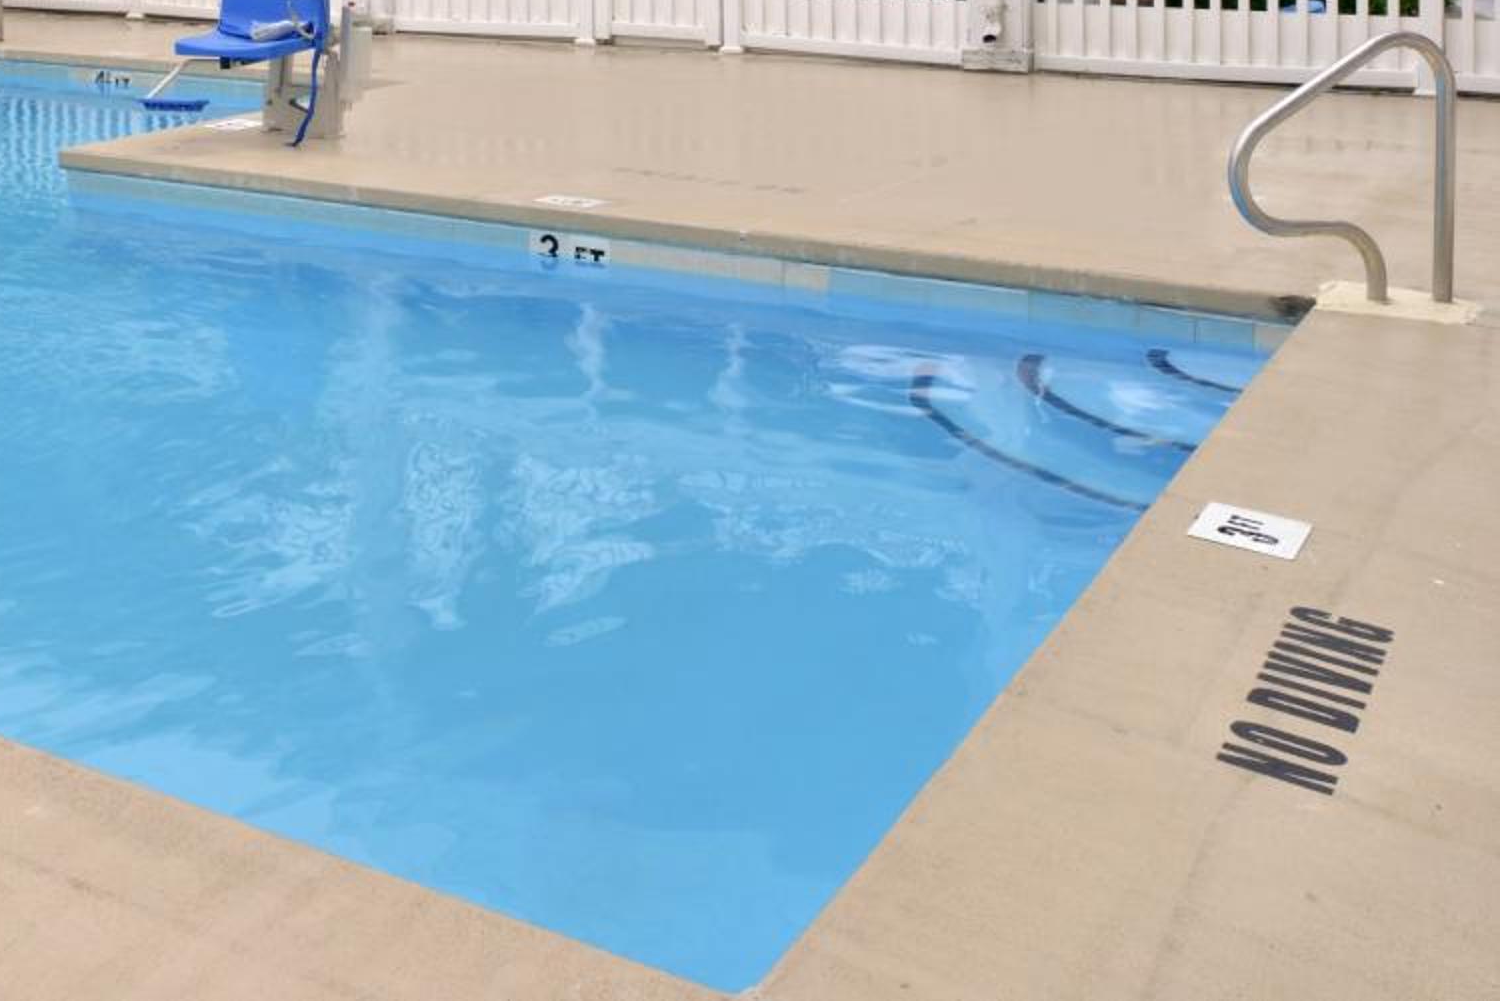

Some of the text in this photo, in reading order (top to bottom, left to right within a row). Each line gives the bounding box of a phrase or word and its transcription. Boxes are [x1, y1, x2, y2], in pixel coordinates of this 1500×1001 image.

[1217, 526, 1279, 545] 3
[1215, 606, 1396, 797] NO DIVING
